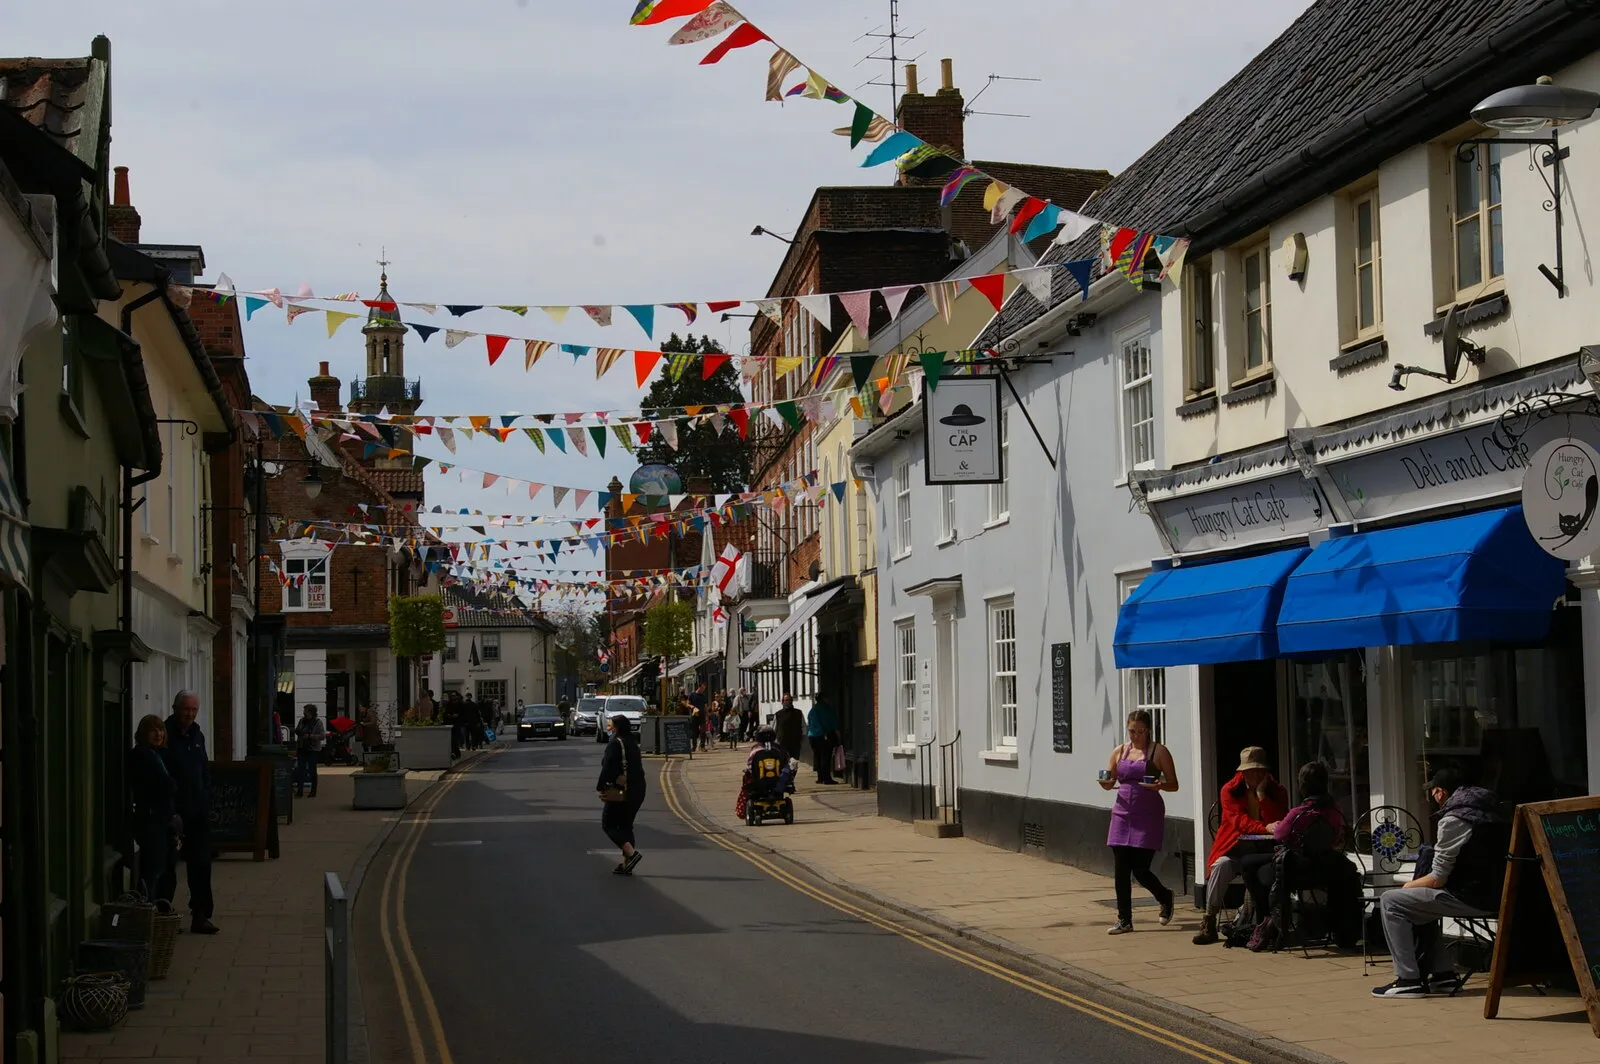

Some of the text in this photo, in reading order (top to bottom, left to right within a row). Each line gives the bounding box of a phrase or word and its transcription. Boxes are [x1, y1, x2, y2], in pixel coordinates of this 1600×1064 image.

[949, 434, 977, 447] CAP
[958, 460, 969, 471] &
[1400, 447, 1448, 489] Deli
[1446, 436, 1488, 482] and
[1557, 452, 1585, 466] Hungry
[1571, 467, 1584, 478] Cat
[1571, 480, 1584, 491] Cafe
[1185, 483, 1289, 541] Hungry Cat Cafe
[313, 593, 326, 601] LET
[1542, 816, 1578, 838] Hungry
[1576, 814, 1596, 833] Cat
